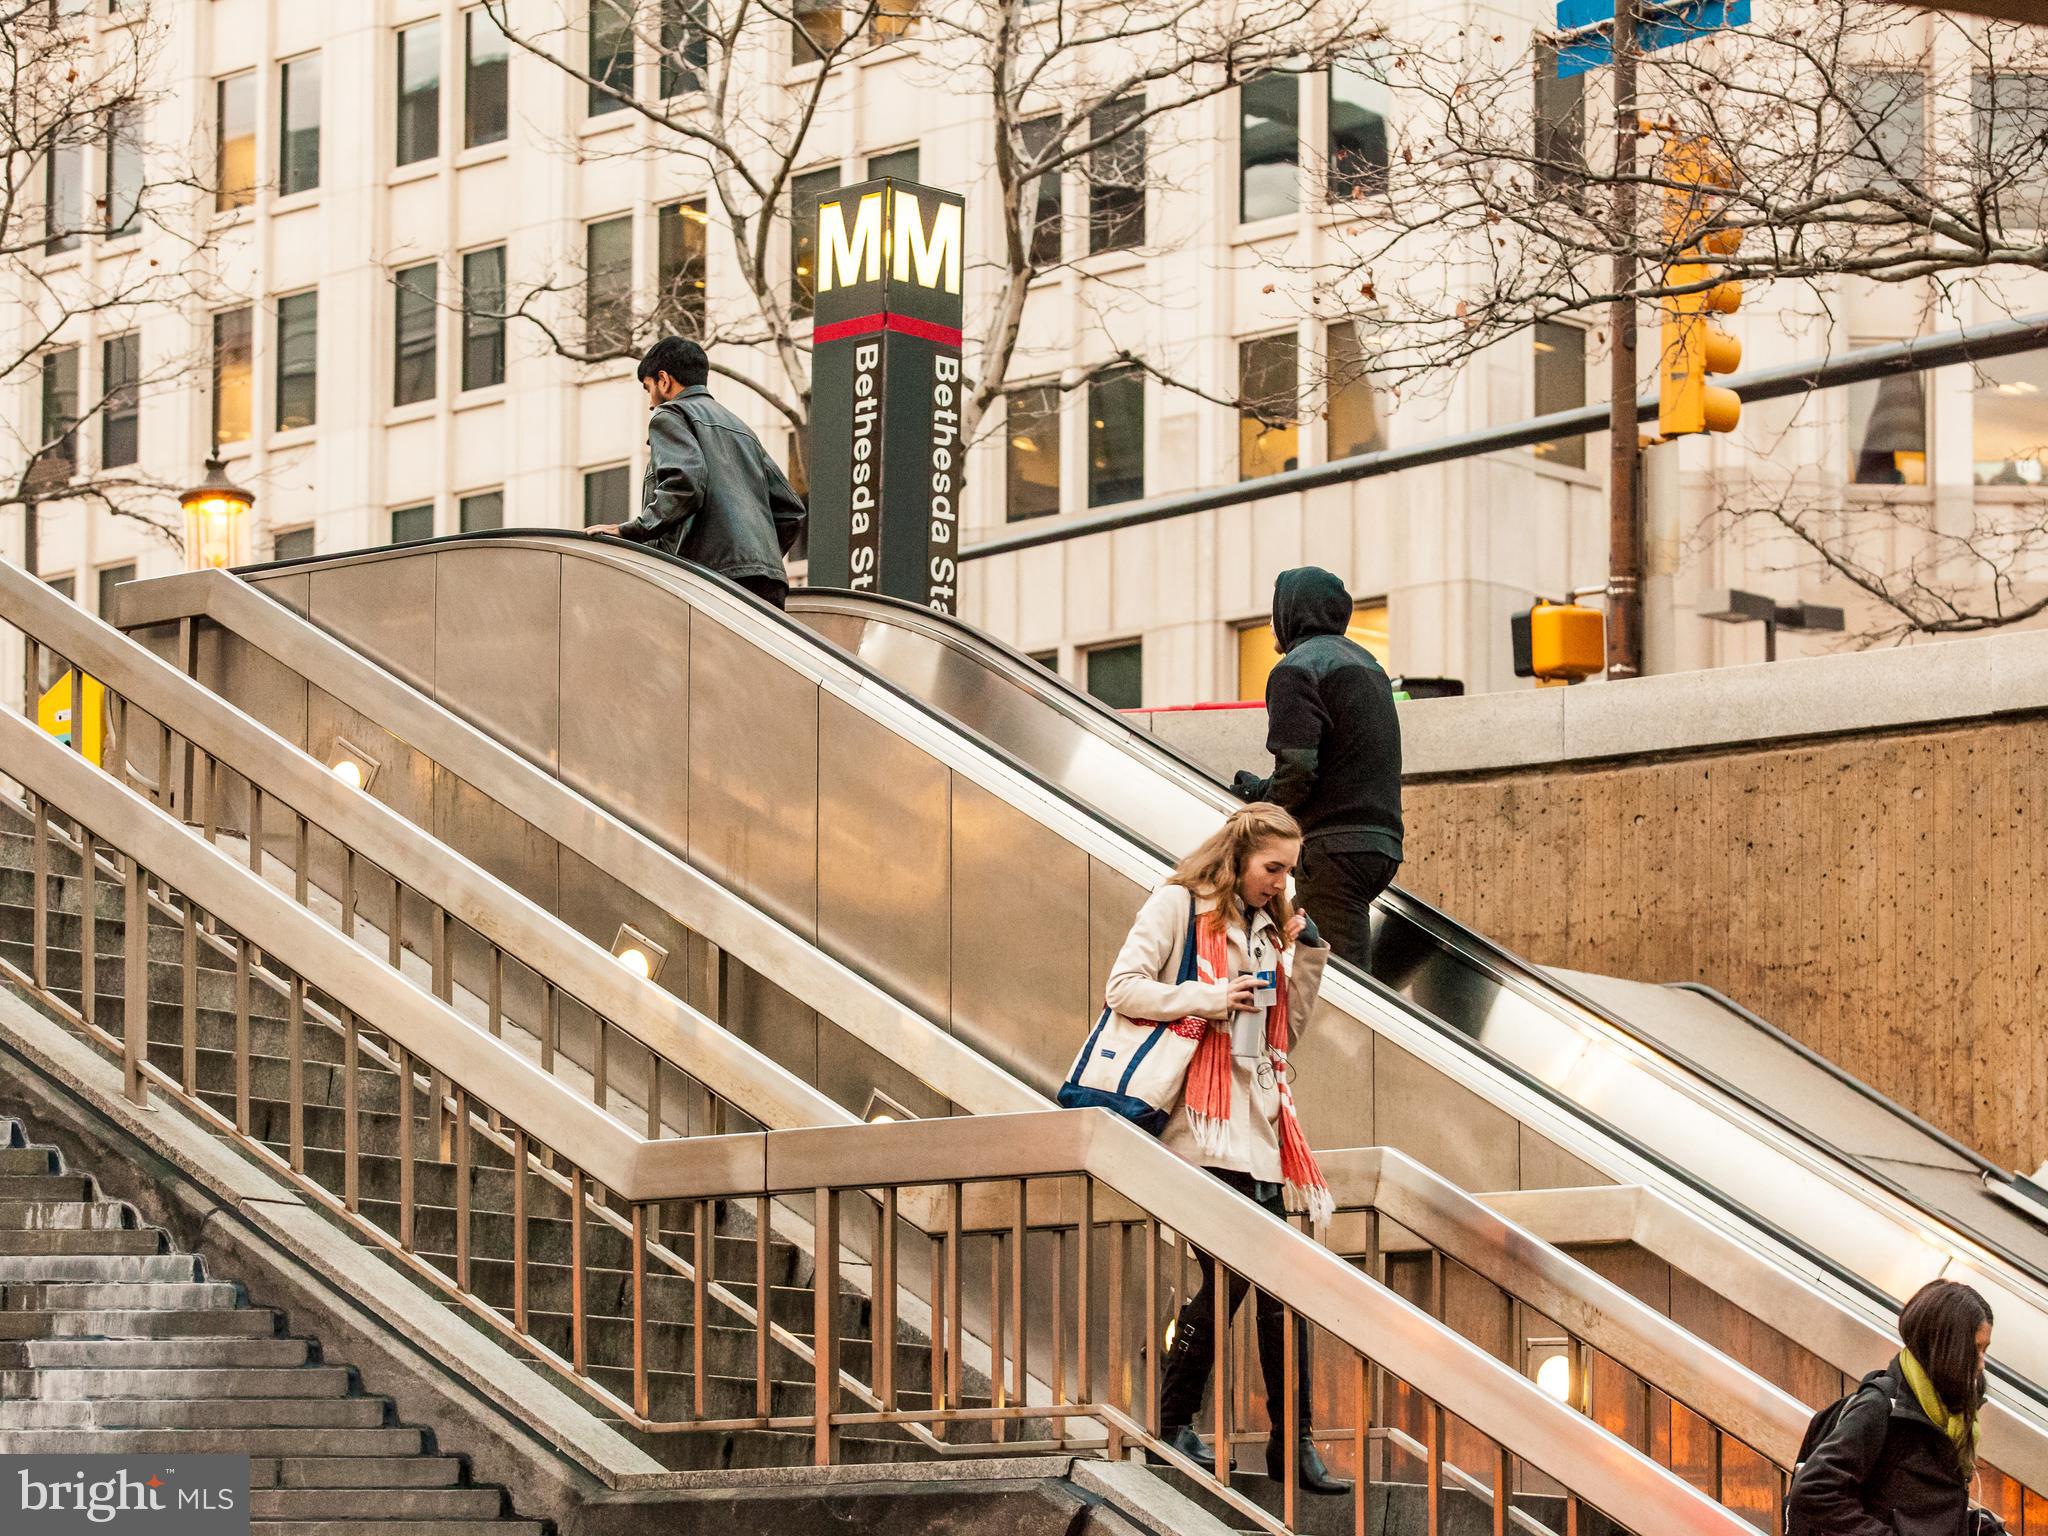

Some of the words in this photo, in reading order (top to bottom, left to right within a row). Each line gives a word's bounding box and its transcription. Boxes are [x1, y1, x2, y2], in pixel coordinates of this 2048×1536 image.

[818, 191, 882, 294] M
[893, 190, 962, 294] M
[852, 343, 879, 536] Bethesda
[930, 354, 959, 544] Bethesda
